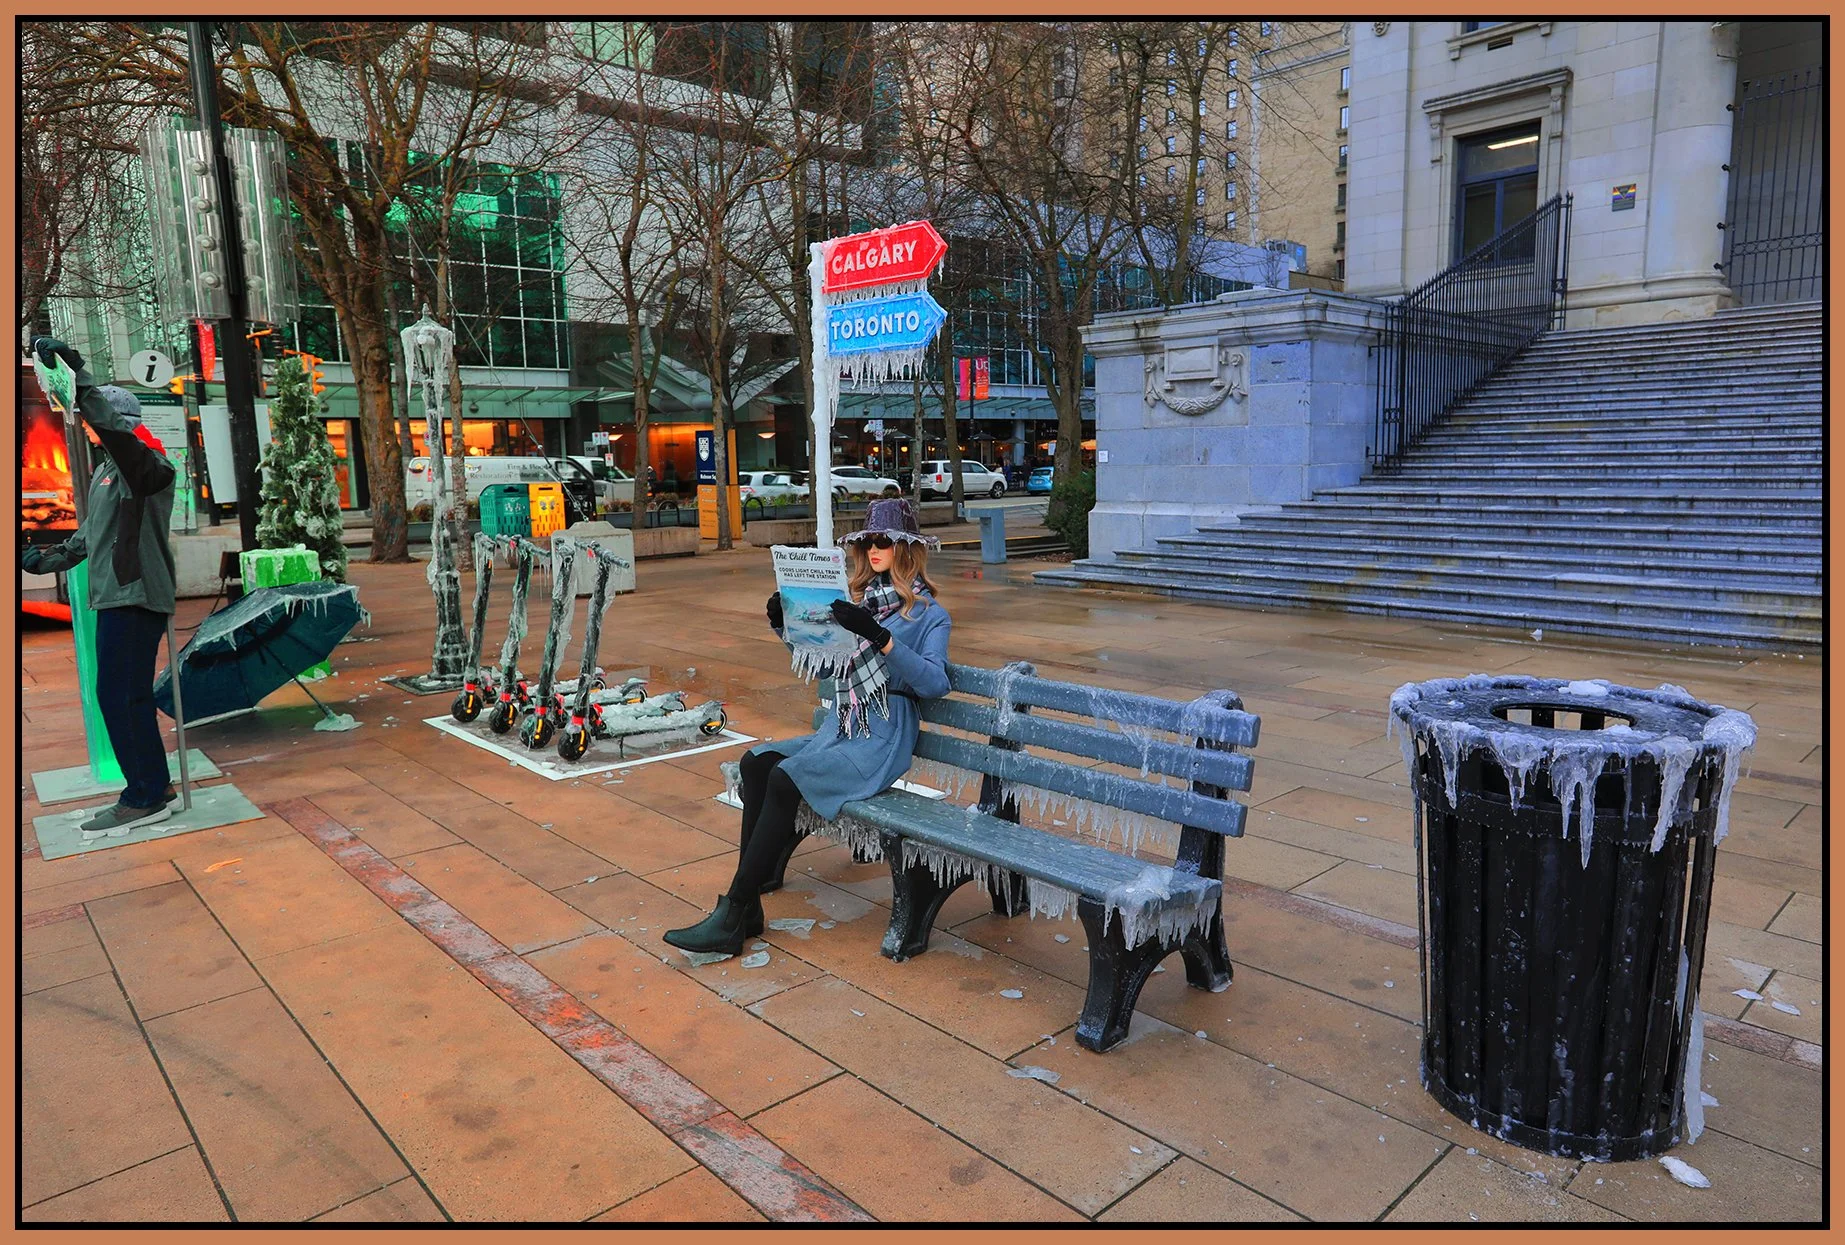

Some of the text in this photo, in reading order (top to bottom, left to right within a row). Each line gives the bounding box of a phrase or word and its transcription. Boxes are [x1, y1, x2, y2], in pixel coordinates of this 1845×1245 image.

[831, 240, 918, 275] CALGARY
[831, 311, 920, 341] TORONTO
[774, 551, 831, 562] The Chill Times
